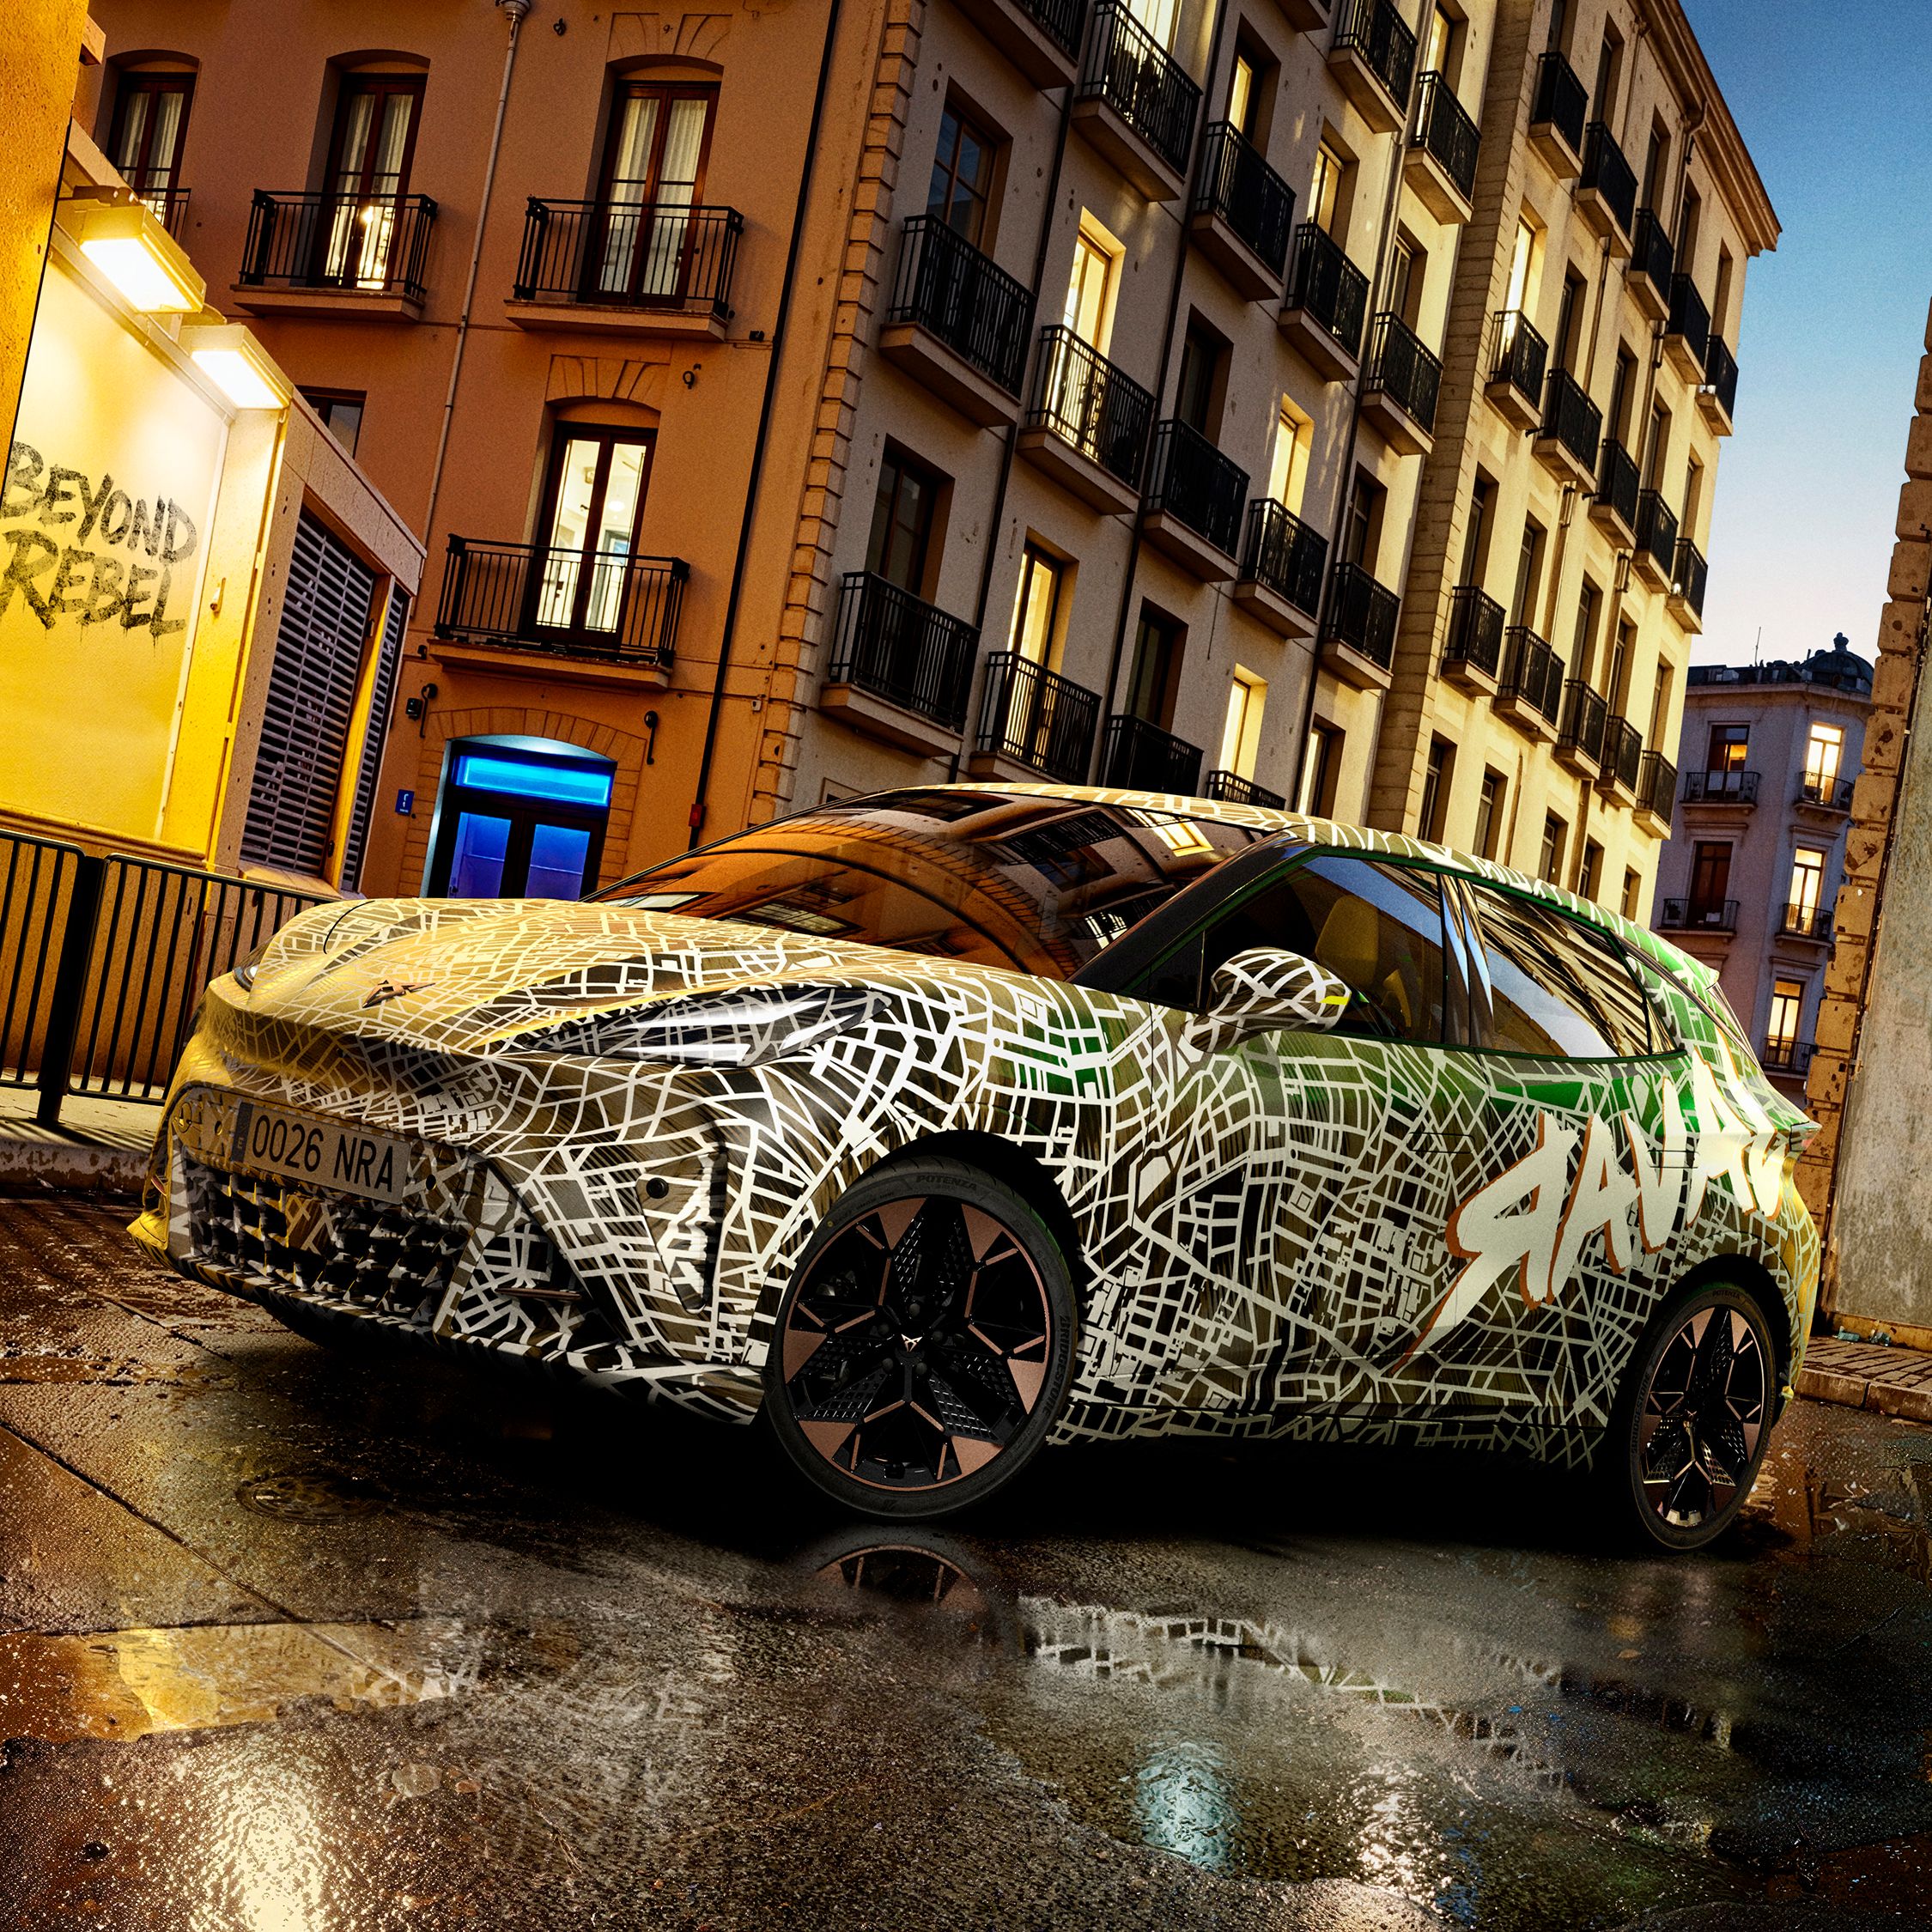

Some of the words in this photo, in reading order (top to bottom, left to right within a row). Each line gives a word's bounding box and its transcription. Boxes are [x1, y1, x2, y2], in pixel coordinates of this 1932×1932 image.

[0, 440, 197, 563] BEYOND
[0, 529, 186, 640] REBEL
[252, 1115, 324, 1172] 0026
[332, 1133, 394, 1193] NRA
[915, 1175, 978, 1192] POTENZA
[1042, 1315, 1071, 1420] BRIDGESTONE
